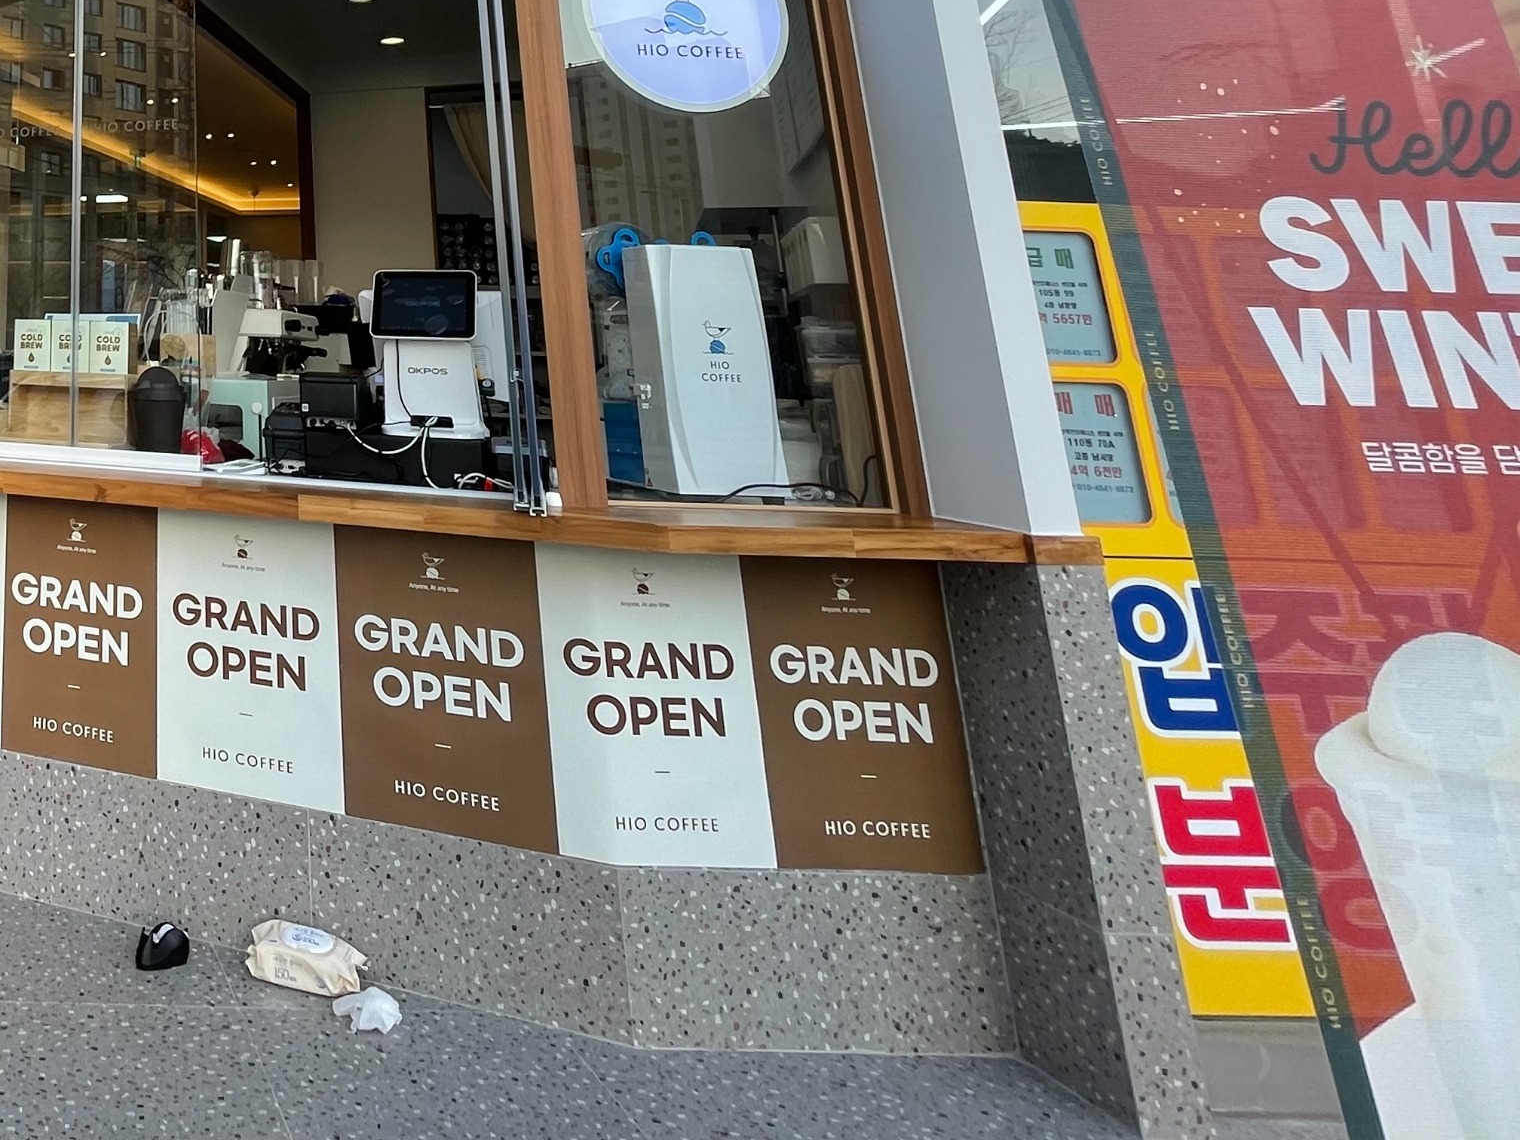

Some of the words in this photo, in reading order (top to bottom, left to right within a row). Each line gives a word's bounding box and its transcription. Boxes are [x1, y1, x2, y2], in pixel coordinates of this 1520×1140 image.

[636, 43, 670, 58] HIO
[676, 44, 744, 60] COFFEE
[20, 333, 43, 342] COLD
[20, 341, 43, 350] BREW
[95, 344, 121, 352] BREW
[96, 335, 121, 344] COLD
[407, 366, 449, 376] OKPOS
[709, 360, 731, 371] HIO
[1247, 306, 1520, 411] WIN
[701, 372, 743, 384] COFFEE
[1360, 440, 1489, 475] 달콤함을
[10, 572, 144, 621] GRAND
[171, 592, 321, 643] GRAND
[22, 618, 130, 667] OPEN
[354, 613, 526, 669] GRAND
[186, 641, 307, 692] OPEN
[561, 637, 735, 682] GRAND
[769, 643, 940, 689] GRAND
[372, 665, 513, 723] OPEN
[32, 715, 58, 733] HIO
[61, 718, 114, 744] COFFEE
[585, 693, 727, 739] OPEN
[792, 698, 935, 745] OPEN
[201, 746, 229, 763] HIO
[234, 753, 294, 775] COFFEE
[393, 779, 426, 798] HIO
[431, 785, 501, 812] COFFEE
[614, 815, 647, 832] HIO
[653, 815, 720, 833] COFFEE
[823, 820, 857, 837] HIO
[861, 820, 932, 839] COFFEE
